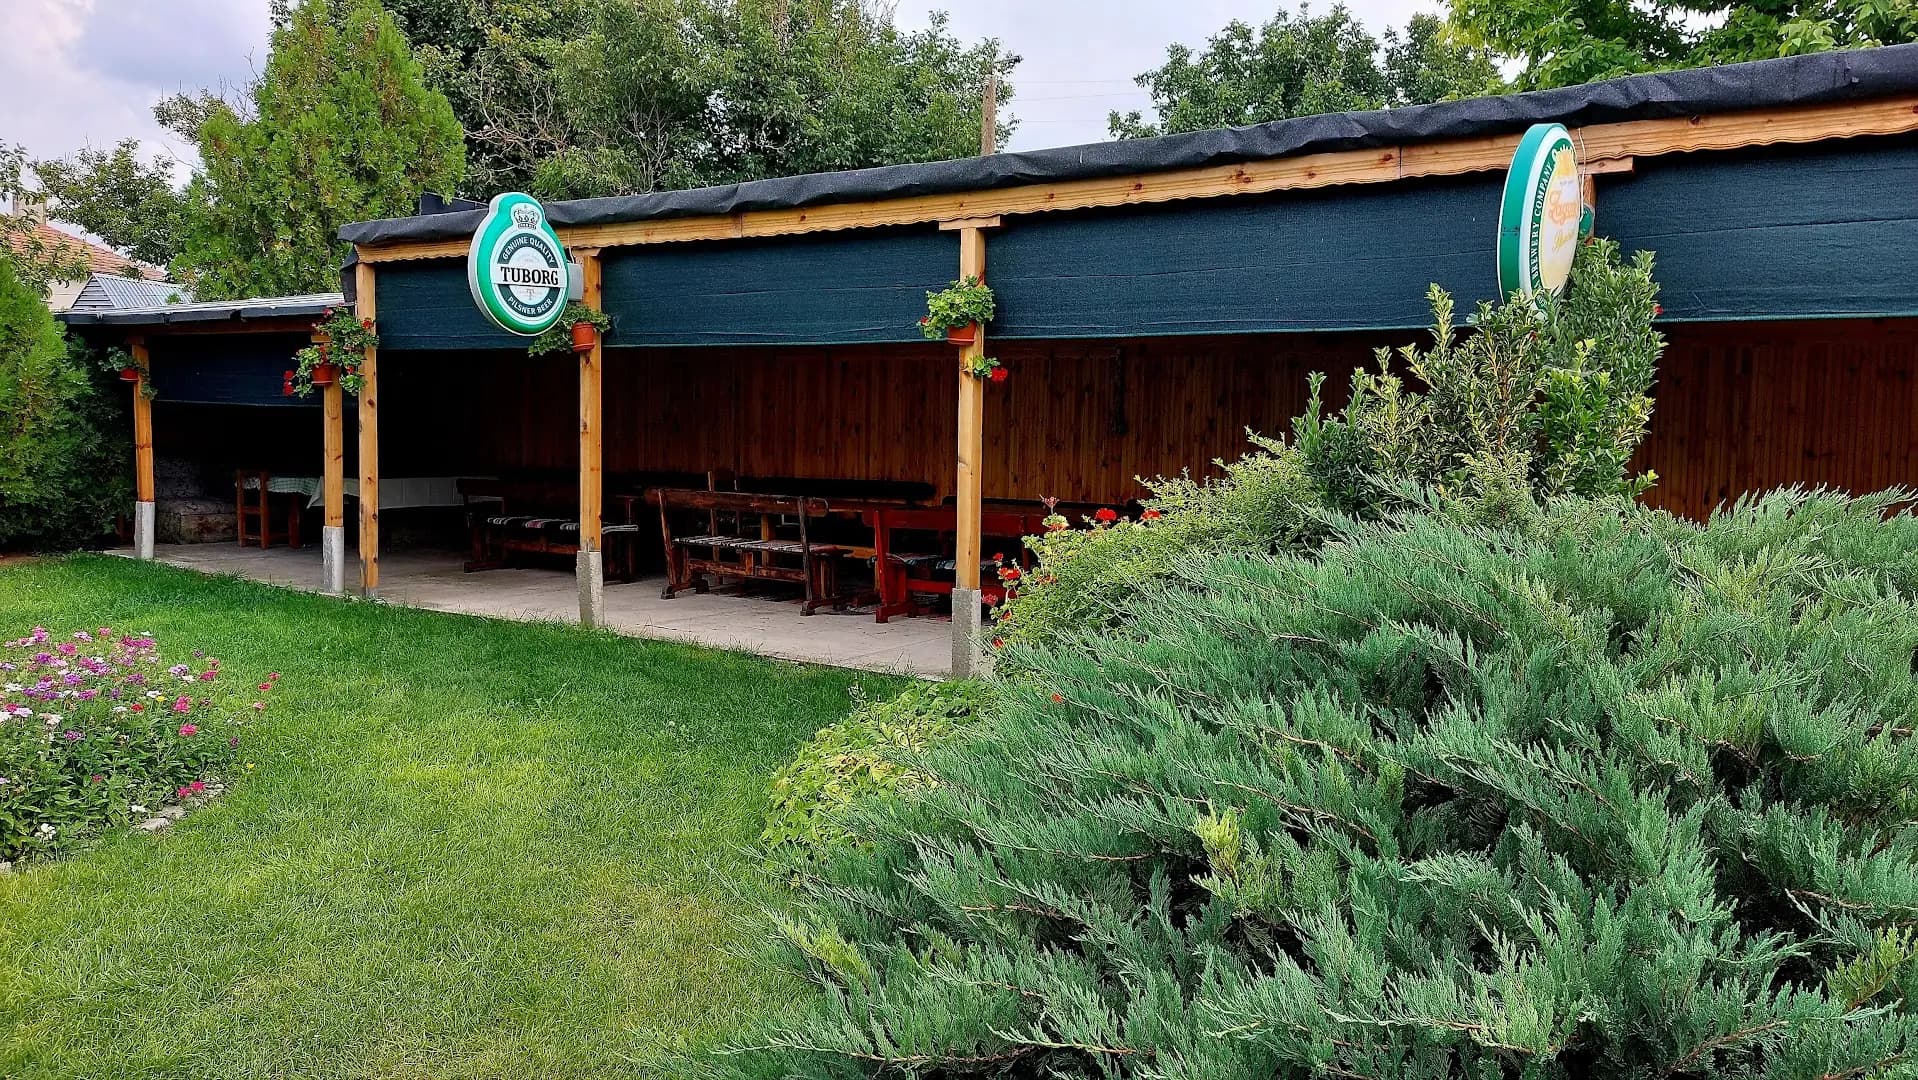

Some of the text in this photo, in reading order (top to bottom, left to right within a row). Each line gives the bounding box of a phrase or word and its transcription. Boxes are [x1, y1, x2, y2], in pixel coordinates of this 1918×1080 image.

[1531, 162, 1553, 278] BREWERY COMPANY
[502, 237, 555, 265] GENUINE QUALITY
[500, 266, 559, 285] TUBORG
[508, 296, 553, 315] PILSNER BEER
